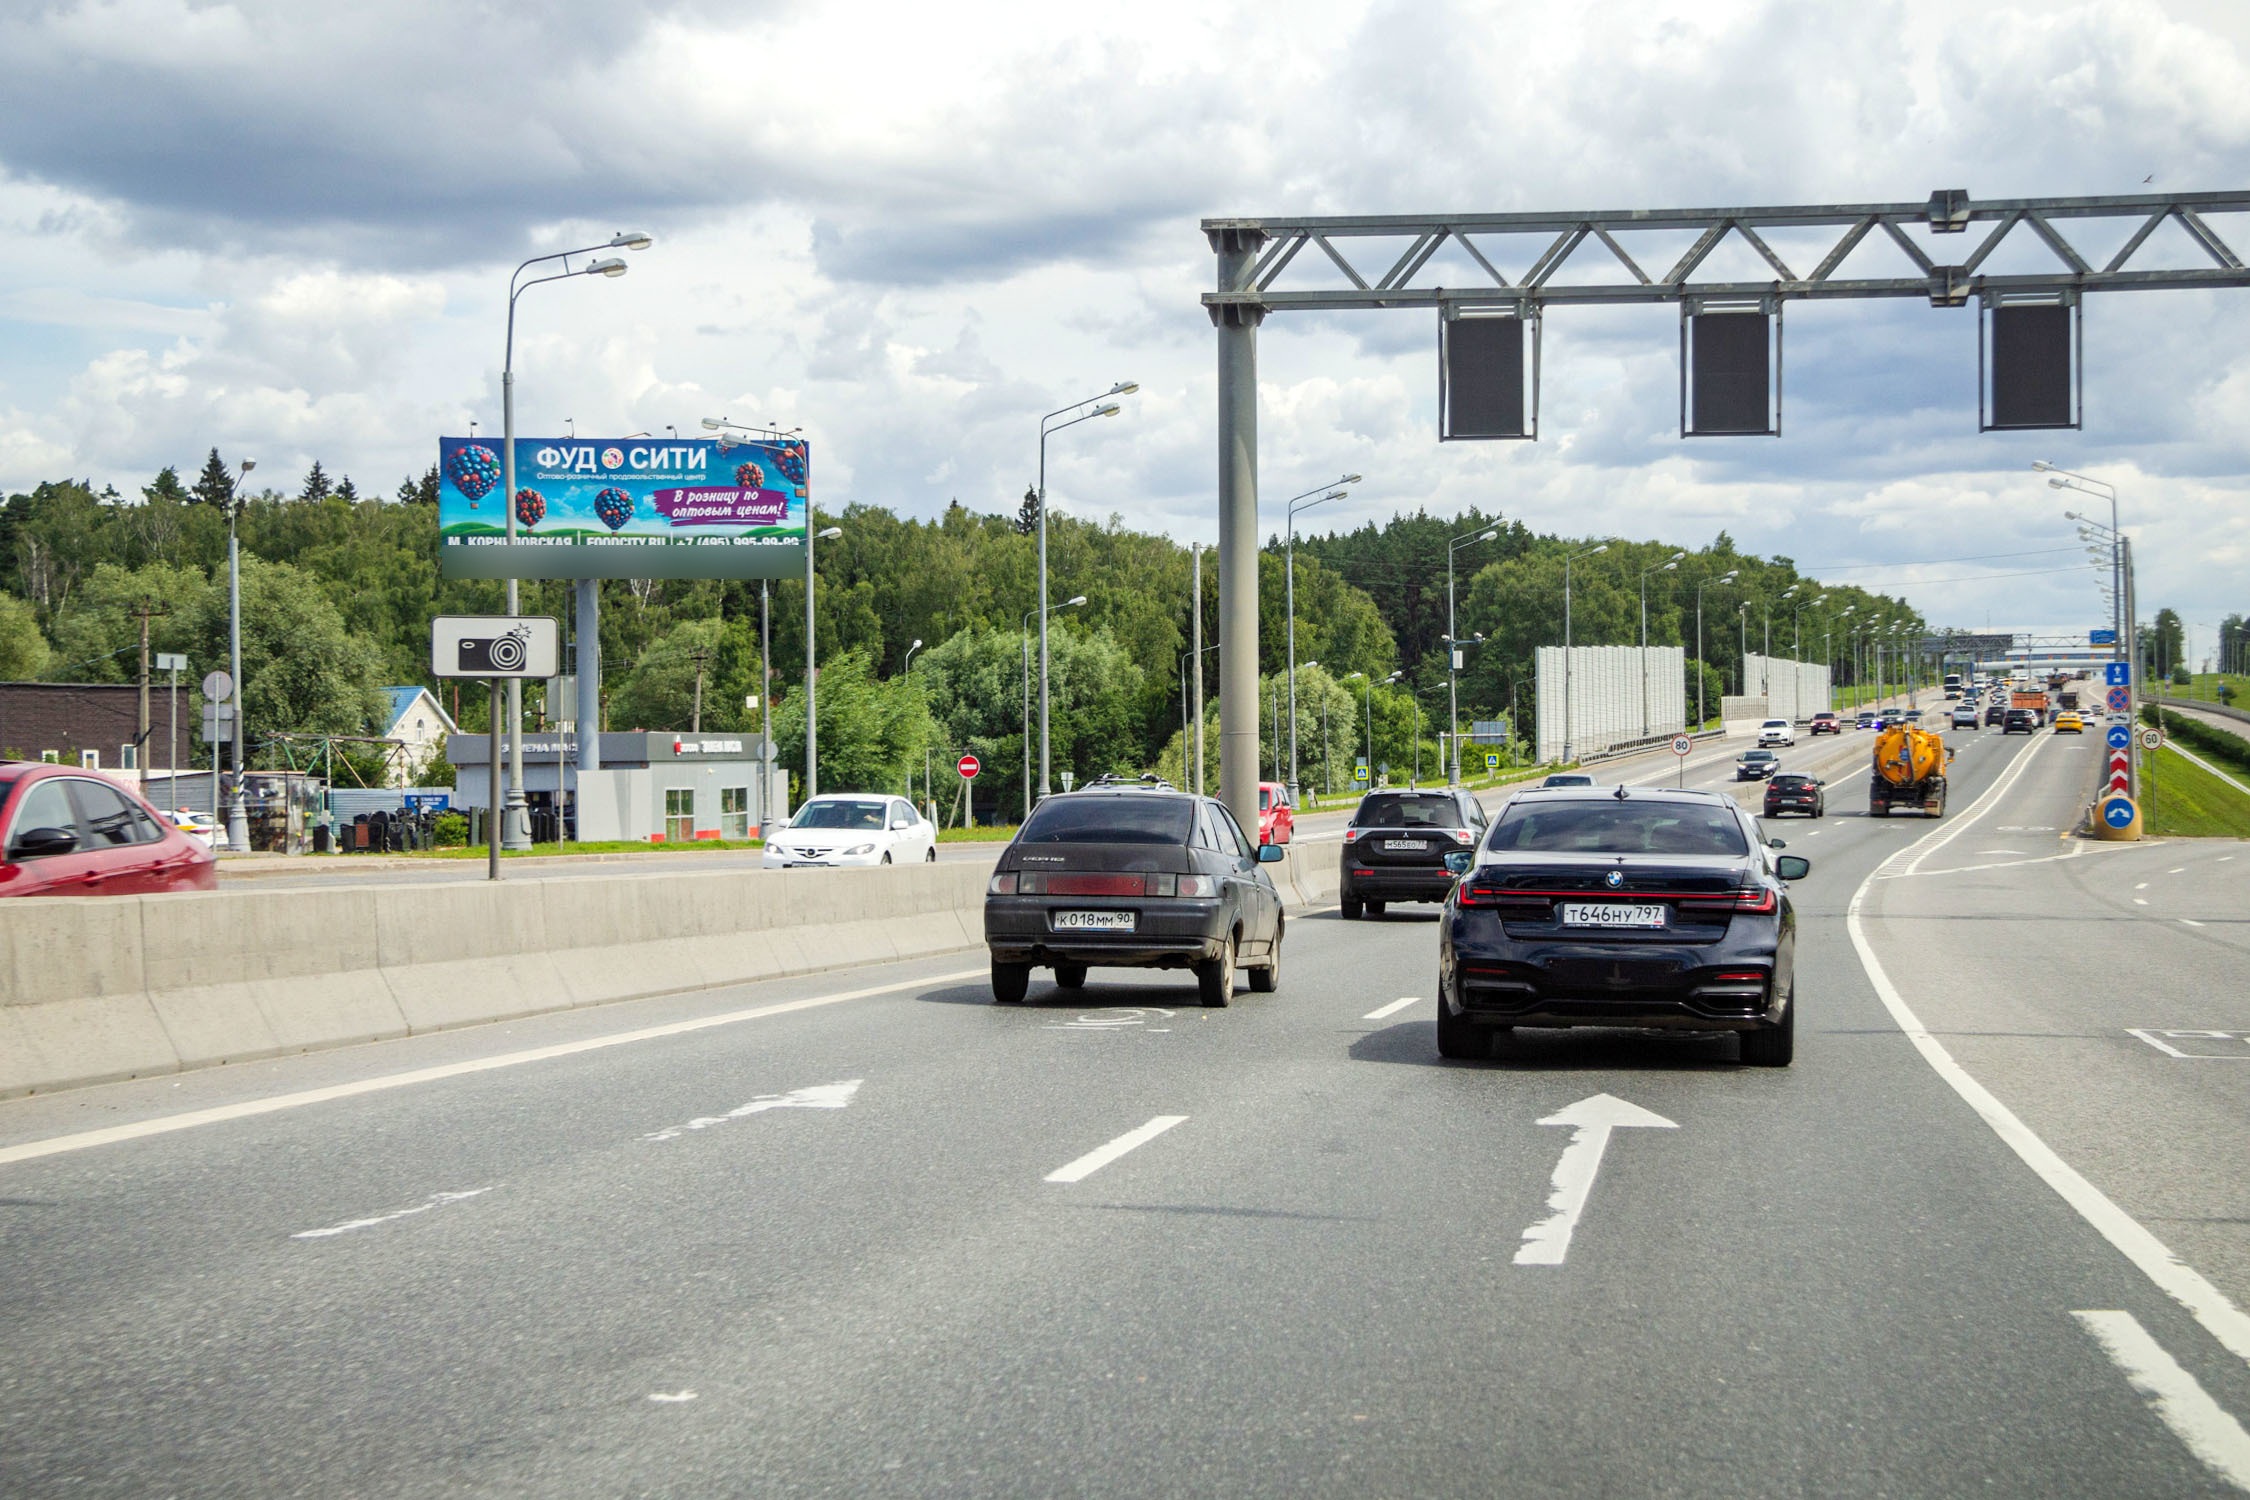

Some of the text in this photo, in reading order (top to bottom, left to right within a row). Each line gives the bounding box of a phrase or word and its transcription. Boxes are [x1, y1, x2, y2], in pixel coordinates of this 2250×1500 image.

[537, 447, 706, 473] ФУД СИТИ
[673, 490, 759, 505] В розницу по
[672, 502, 784, 518] оптовым ценам!
[2145, 733, 2157, 744] 60
[1675, 740, 1688, 750] 80
[1117, 914, 1130, 923] 90
[1636, 907, 1660, 919] 797
